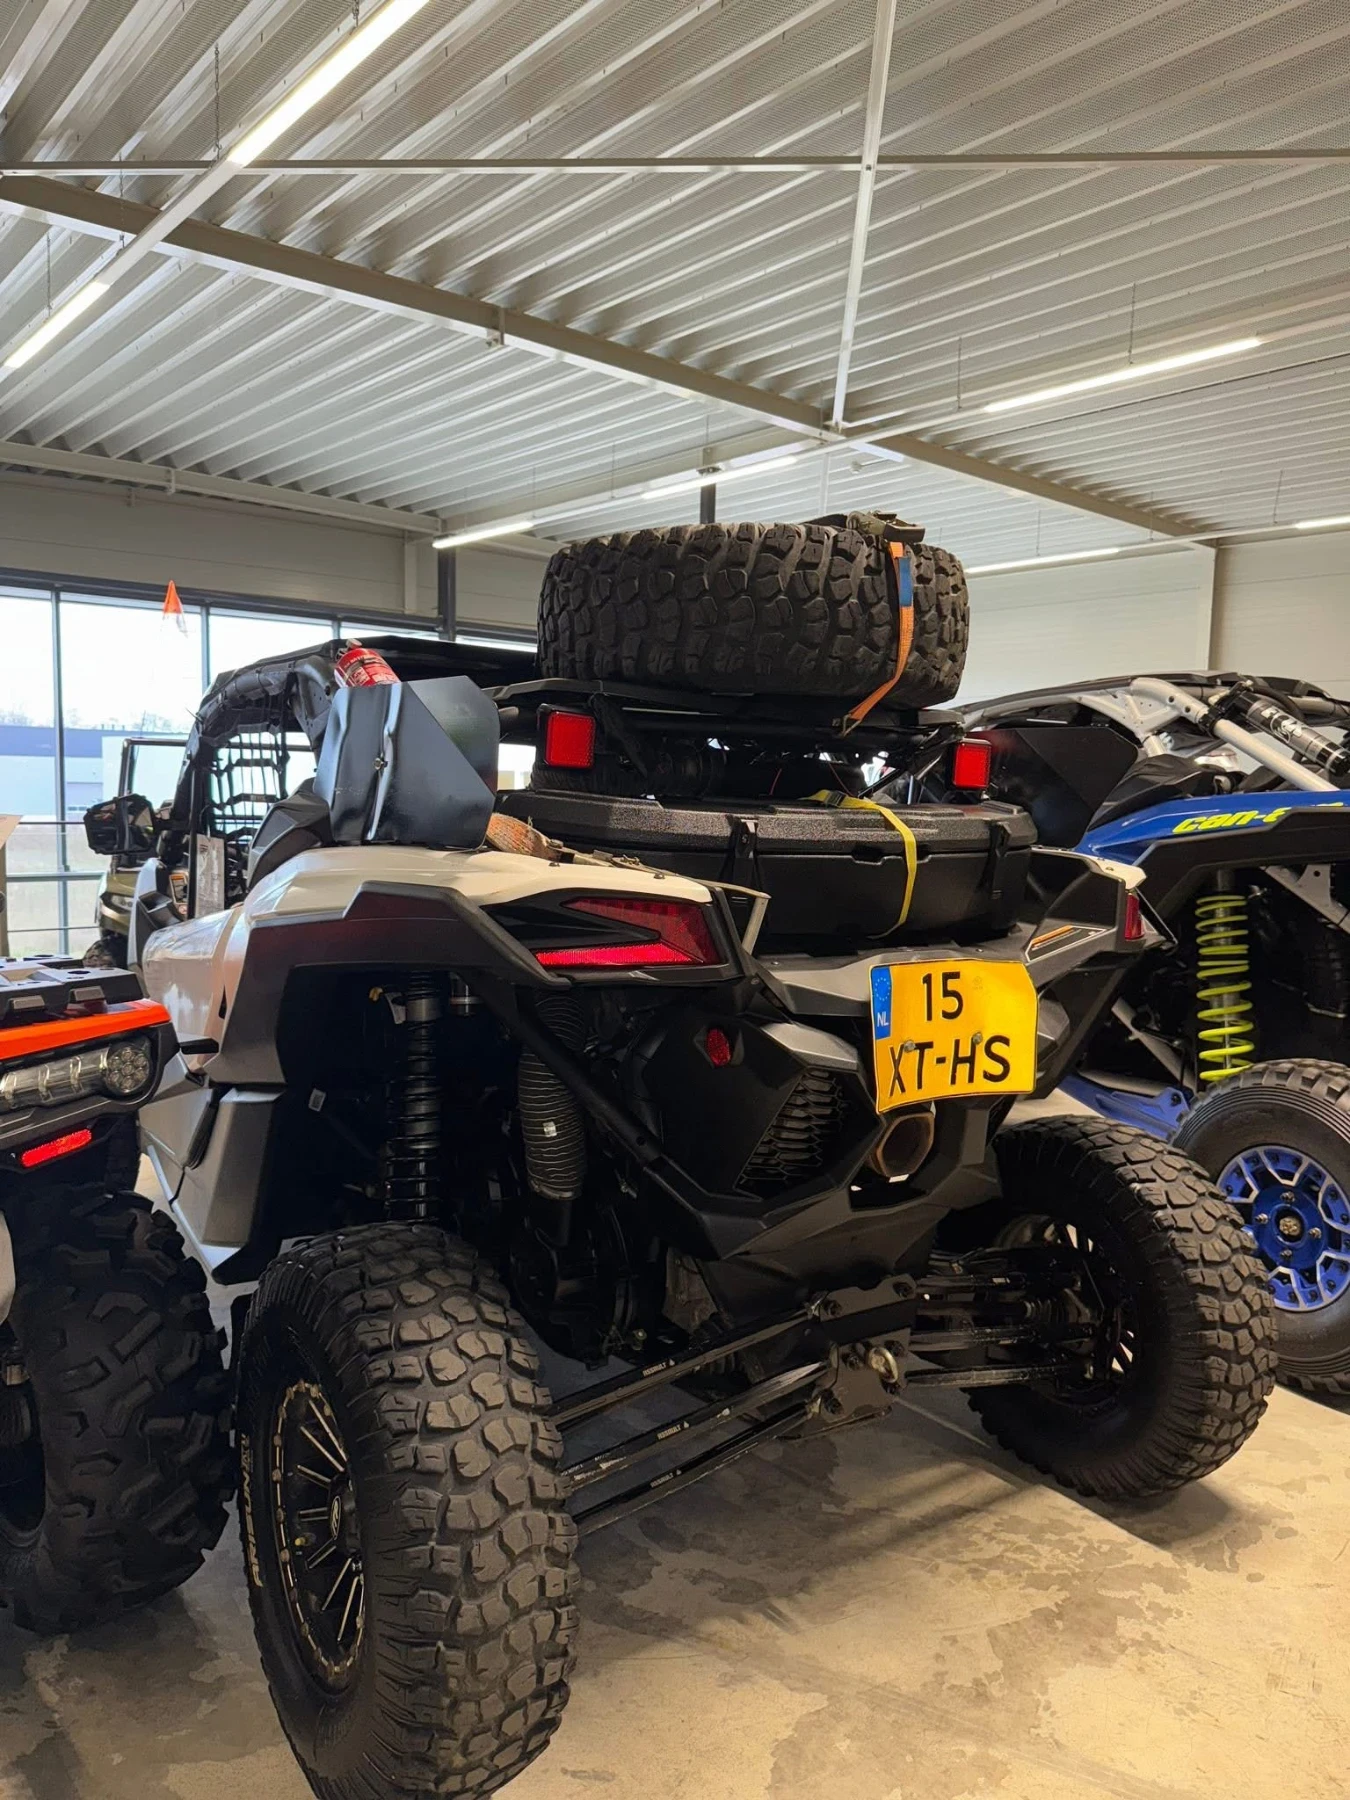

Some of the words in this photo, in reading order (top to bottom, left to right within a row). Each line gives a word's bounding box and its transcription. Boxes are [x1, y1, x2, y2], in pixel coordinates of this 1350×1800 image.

[877, 1011, 889, 1028] NL
[922, 970, 964, 1022] 15
[889, 1034, 1011, 1097] XT-HS
